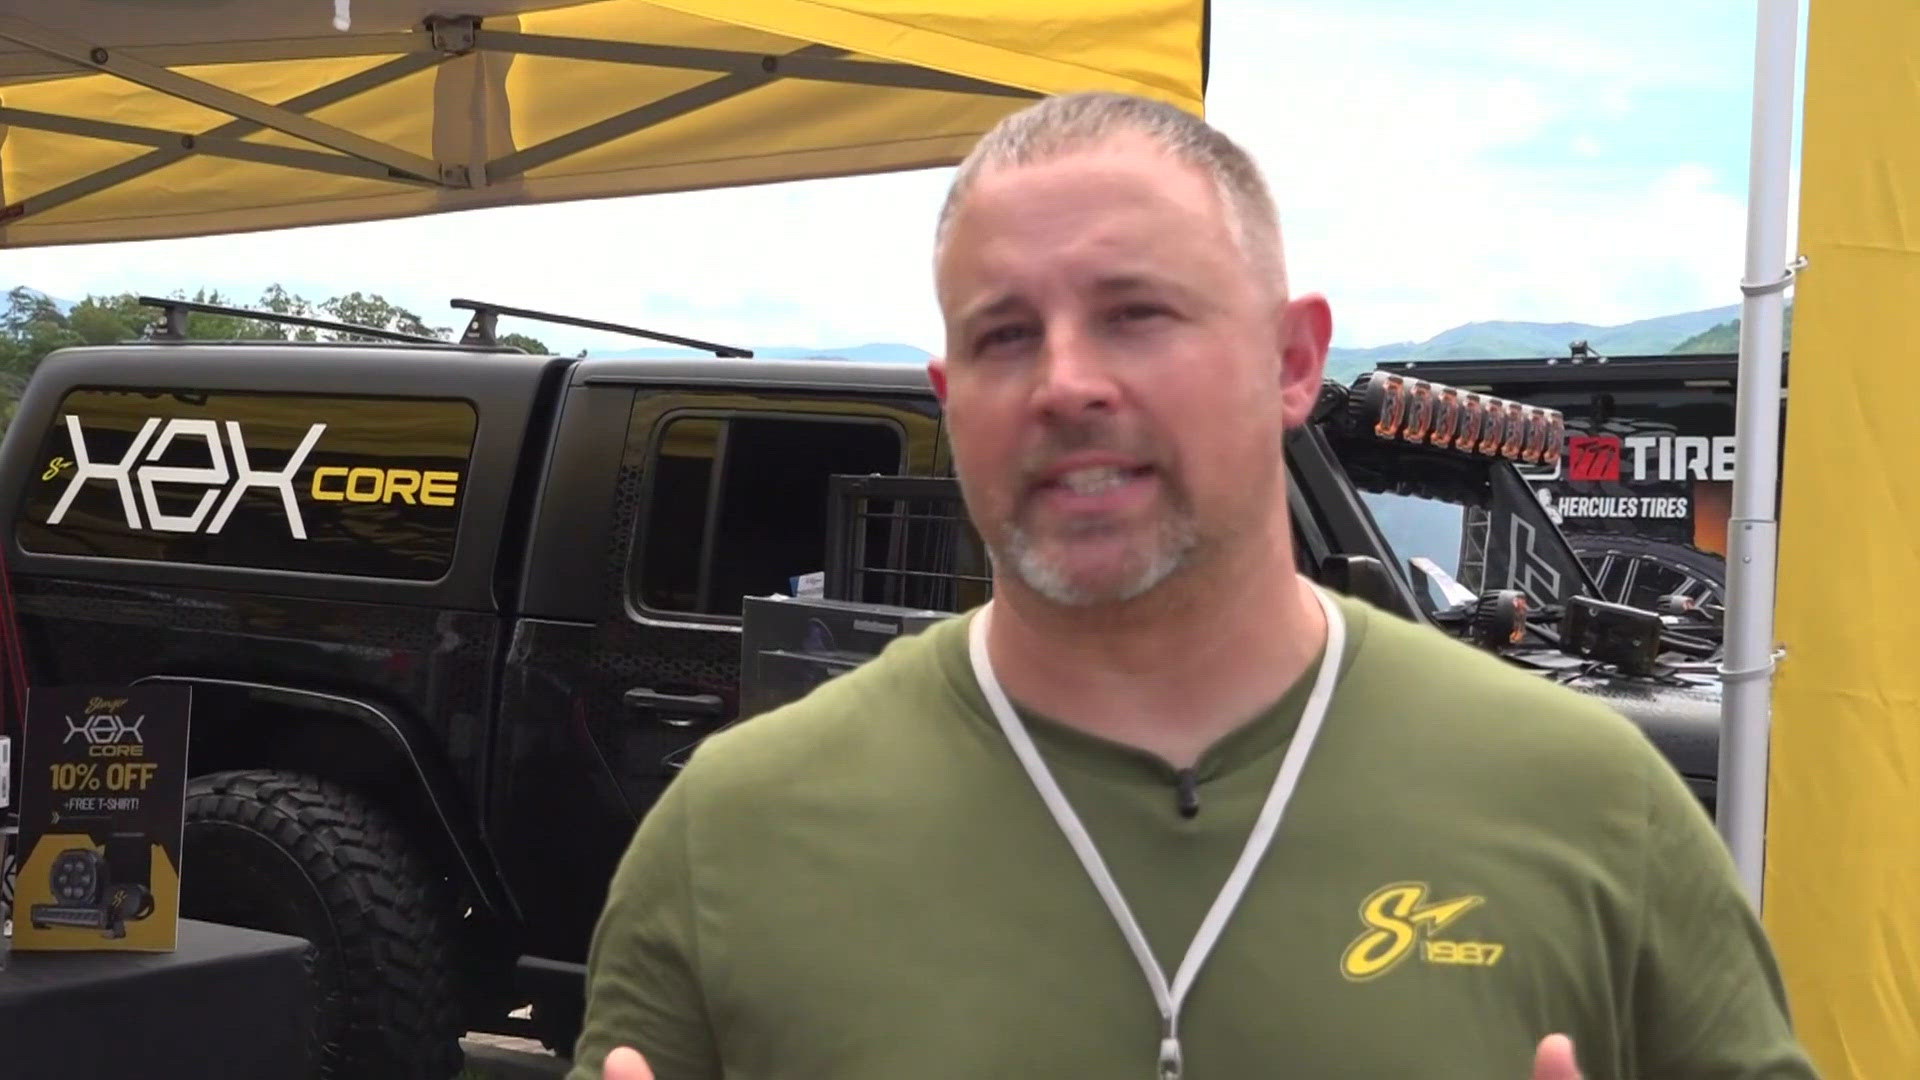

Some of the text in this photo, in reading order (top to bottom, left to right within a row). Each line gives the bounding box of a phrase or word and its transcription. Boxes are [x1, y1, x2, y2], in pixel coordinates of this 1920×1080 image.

[311, 466, 460, 506] CORE
[1557, 497, 1688, 518] HERCULES TIRES
[88, 745, 144, 757] CORE
[50, 762, 158, 791] 10% OFF
[1421, 940, 1504, 966] 1987
